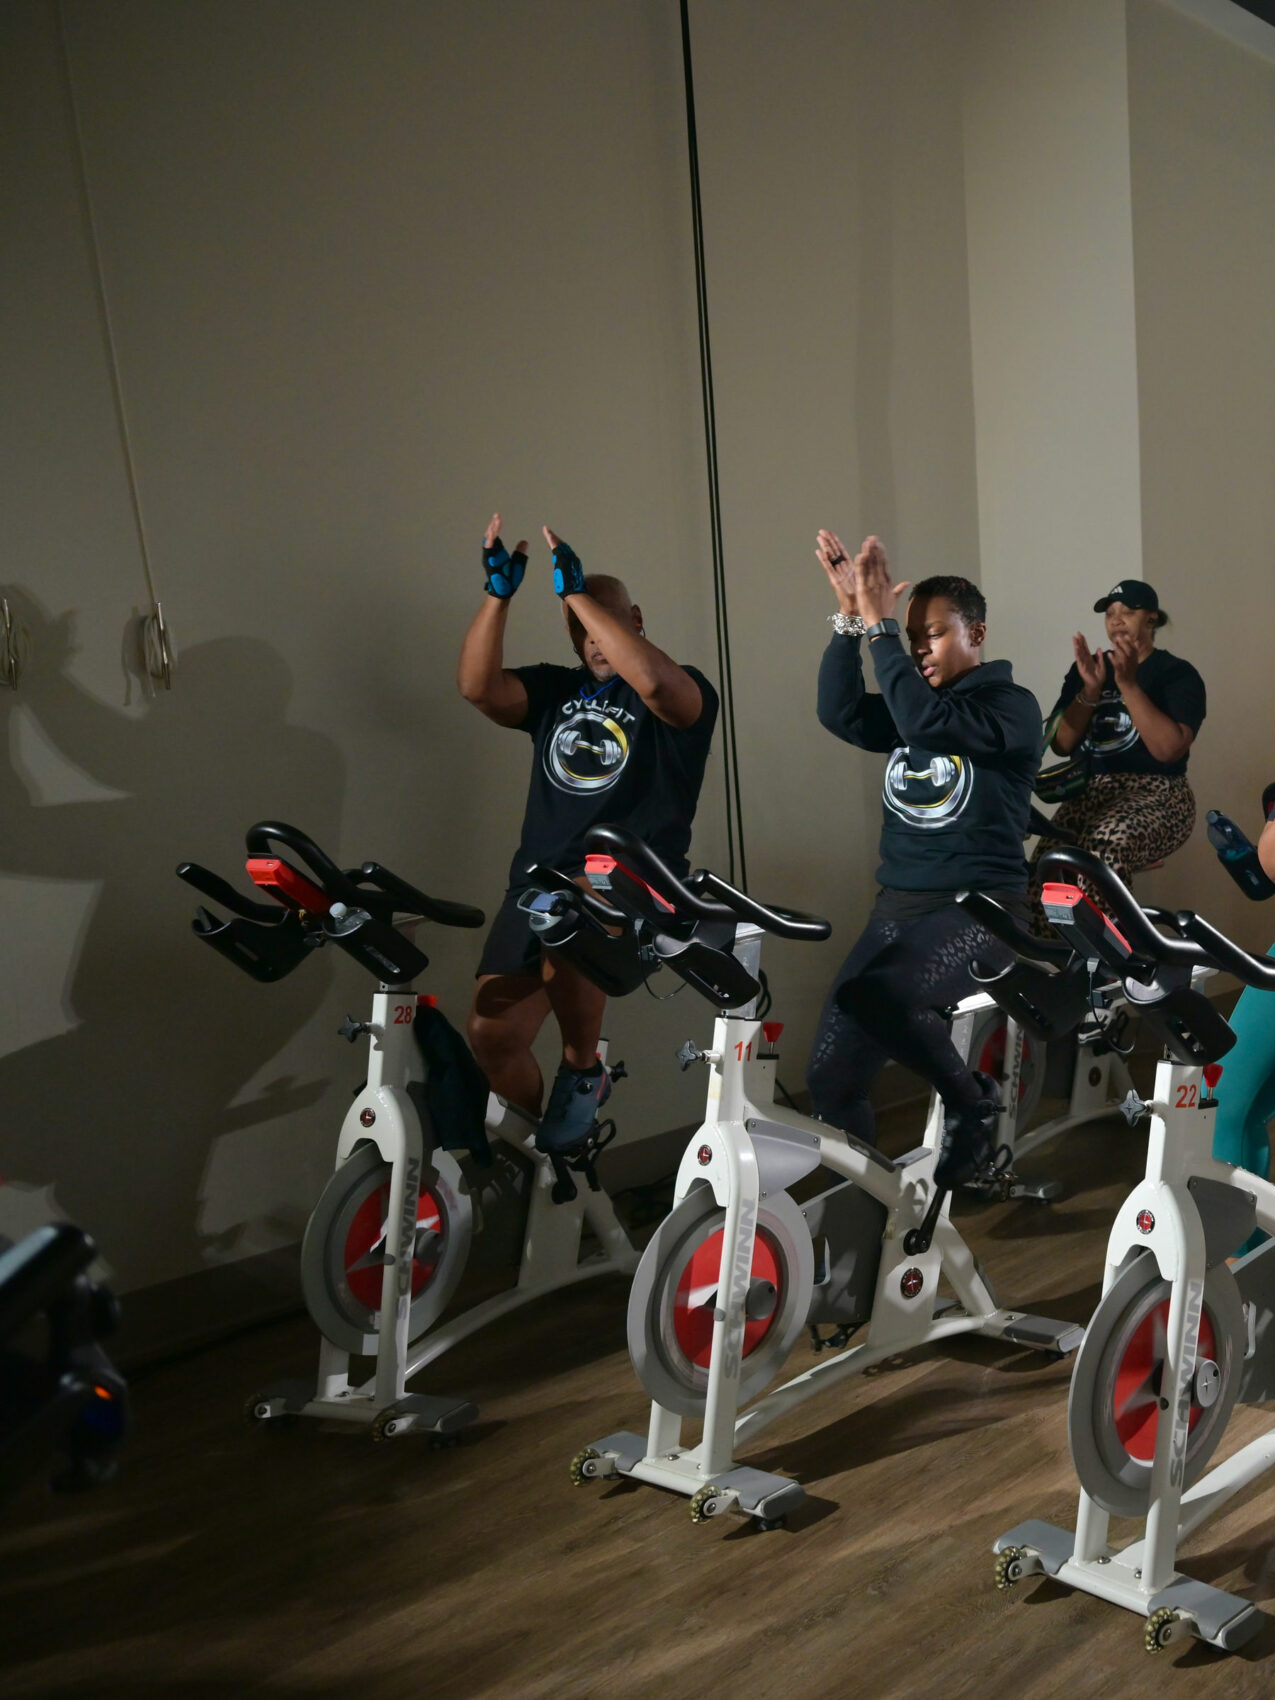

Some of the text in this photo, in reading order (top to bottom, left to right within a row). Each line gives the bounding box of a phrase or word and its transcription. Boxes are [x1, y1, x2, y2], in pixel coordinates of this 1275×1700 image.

[393, 1004, 413, 1025] 28
[734, 1041, 752, 1062] 11
[1175, 1084, 1197, 1108] 22
[724, 1198, 757, 1379] SCHWINN
